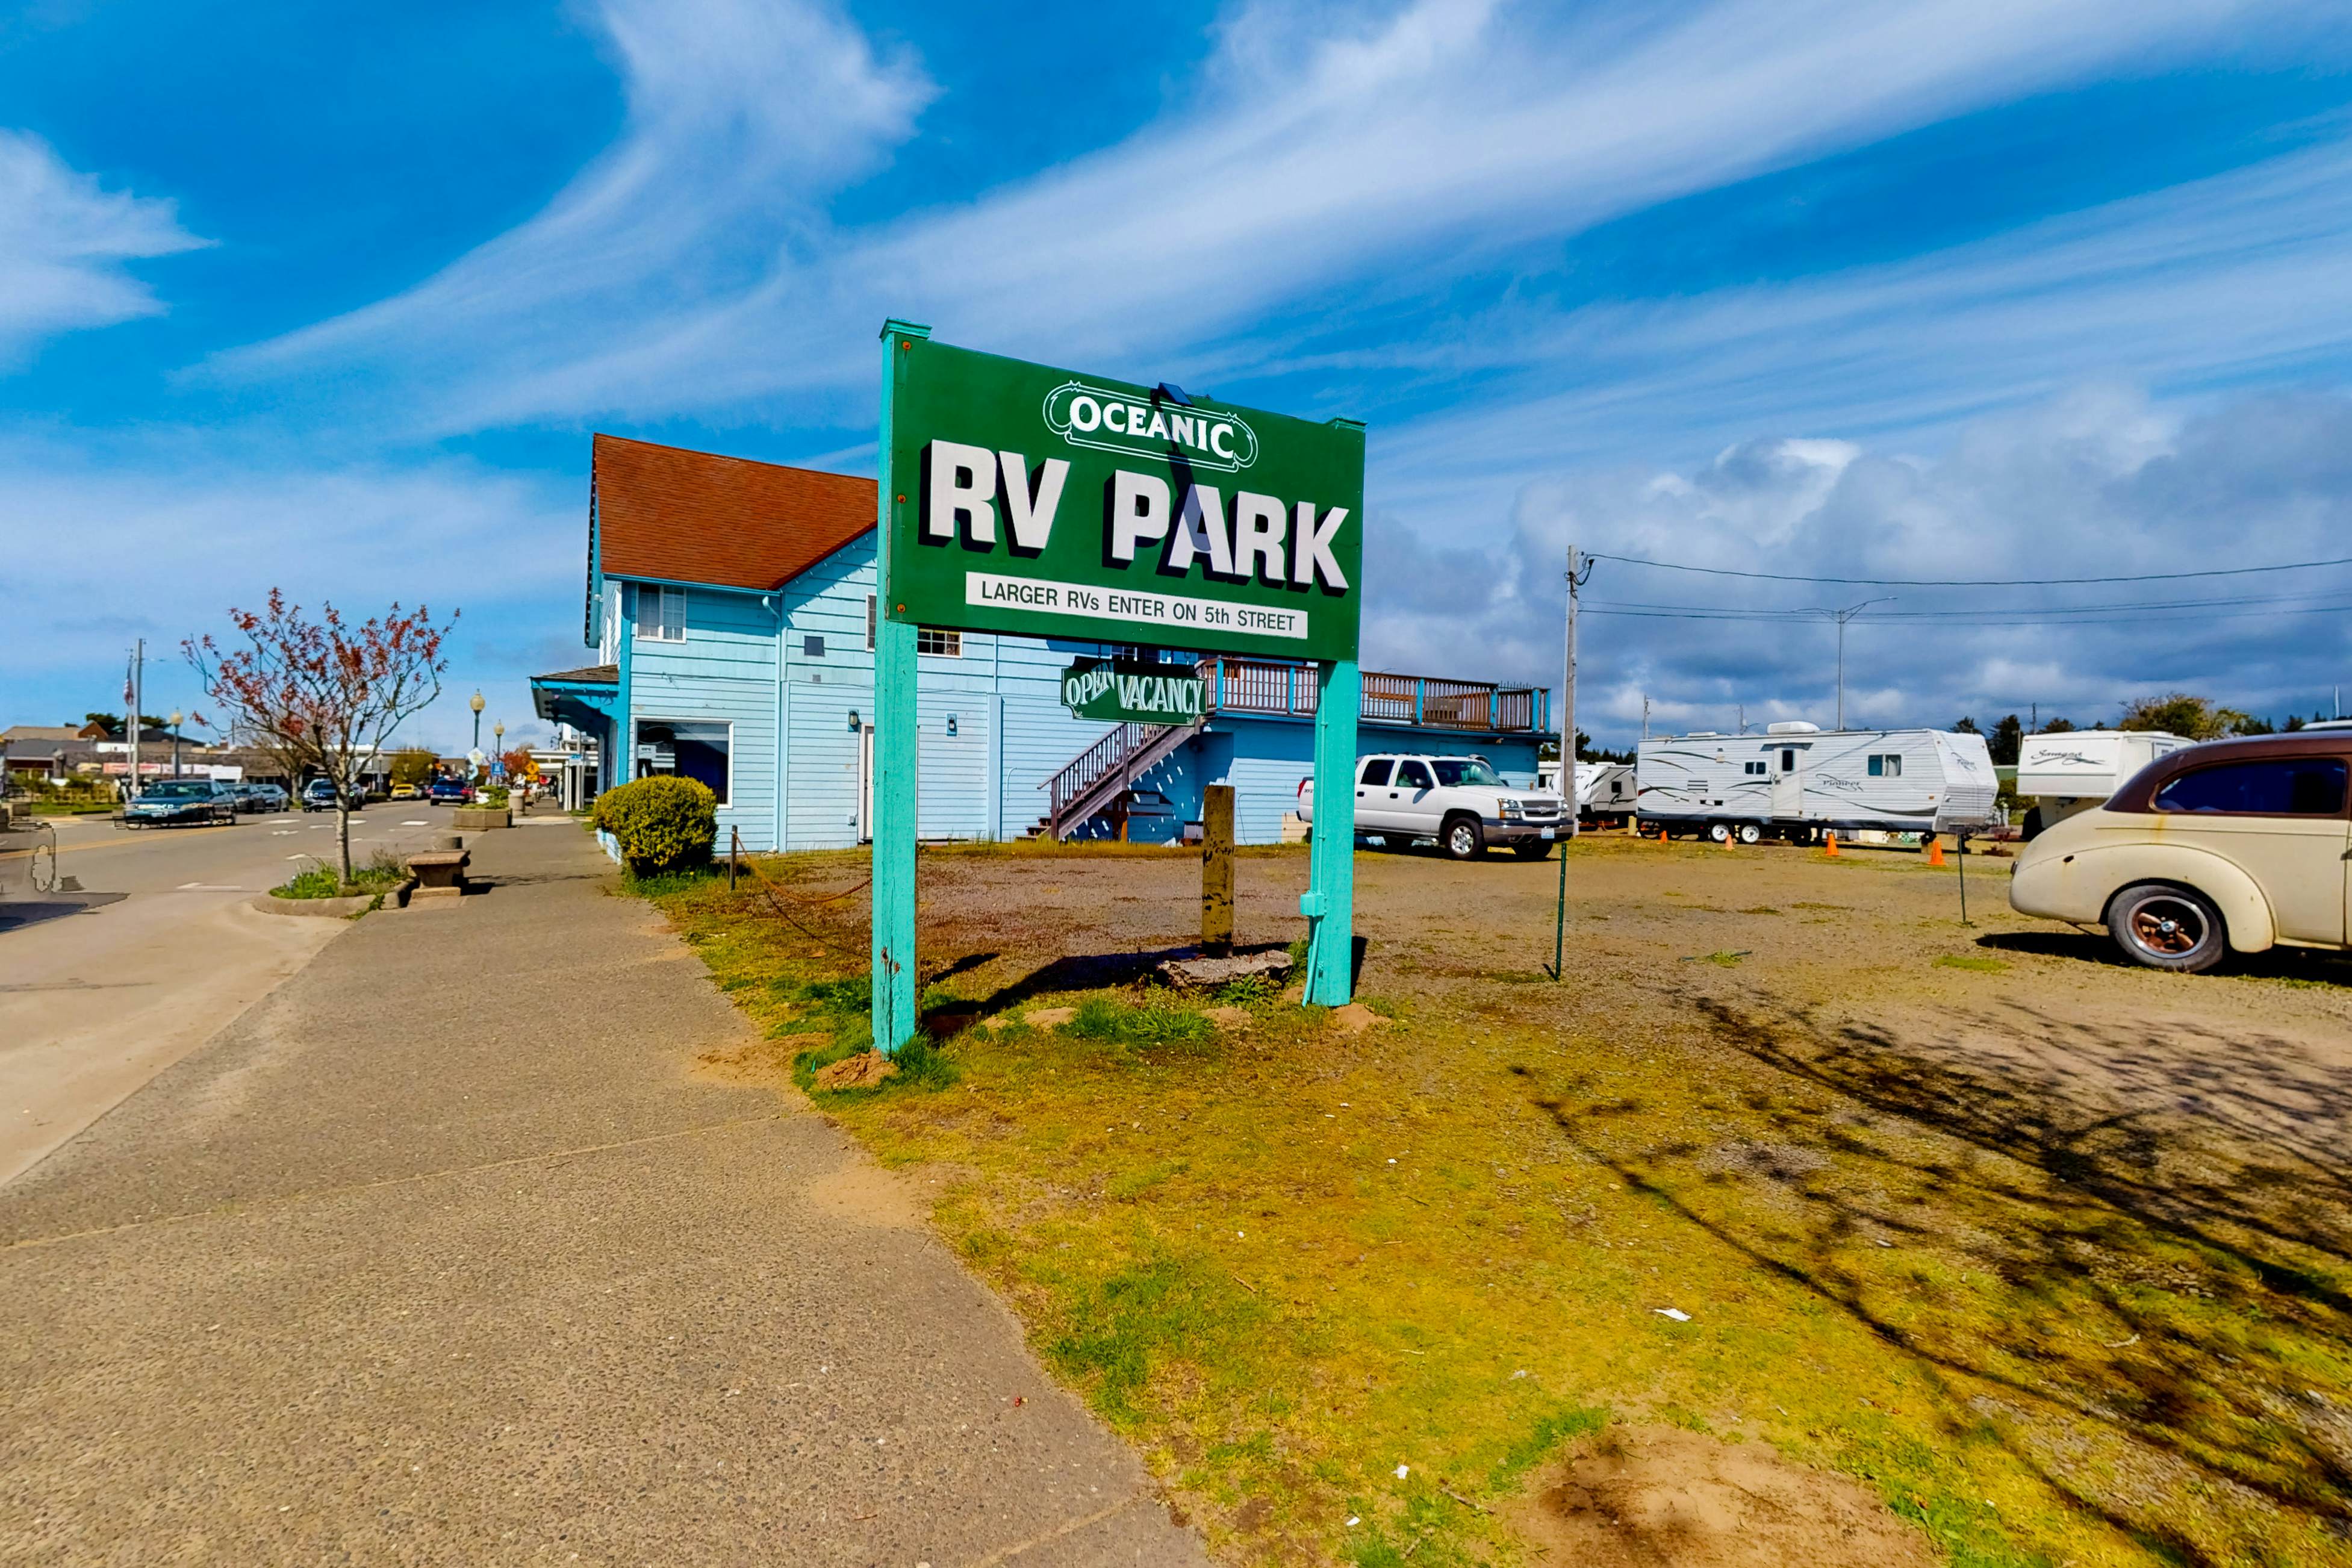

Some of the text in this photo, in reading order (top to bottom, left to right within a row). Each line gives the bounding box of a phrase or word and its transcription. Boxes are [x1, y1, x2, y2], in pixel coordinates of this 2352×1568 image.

[1069, 396, 1234, 459] OCEANIC
[929, 439, 1349, 589] RV PARK
[982, 580, 1295, 631] LARGER RVs ENTER ON 5th STREET
[1065, 661, 1204, 715] OPEN VACANCY
